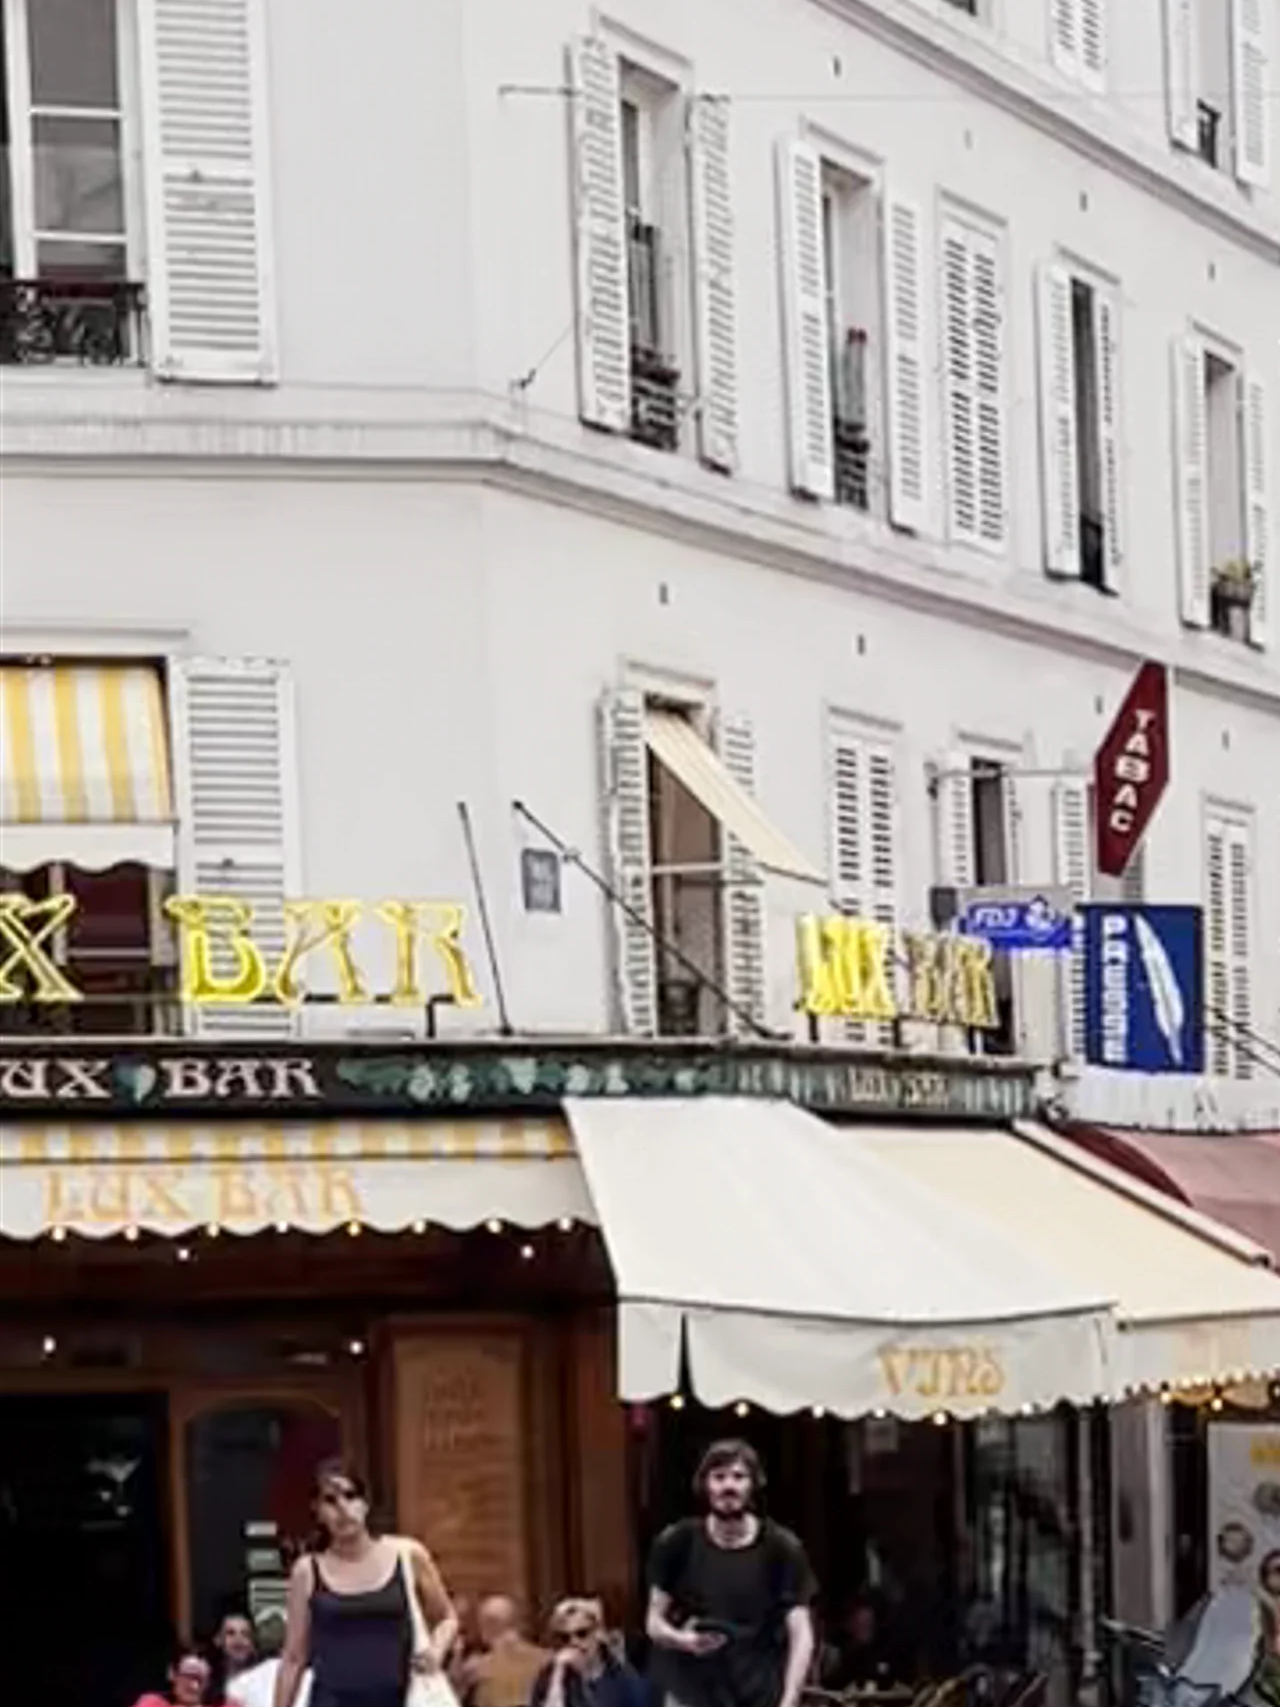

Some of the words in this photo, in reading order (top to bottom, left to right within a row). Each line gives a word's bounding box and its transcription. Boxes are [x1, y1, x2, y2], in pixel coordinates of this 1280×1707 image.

[1109, 708, 1156, 834] TABAC
[165, 893, 484, 1007] BAR
[1101, 913, 1129, 1064] PRESSE
[157, 1057, 326, 1098] BAR
[43, 1166, 193, 1224] LUX
[208, 1165, 366, 1224] BAR
